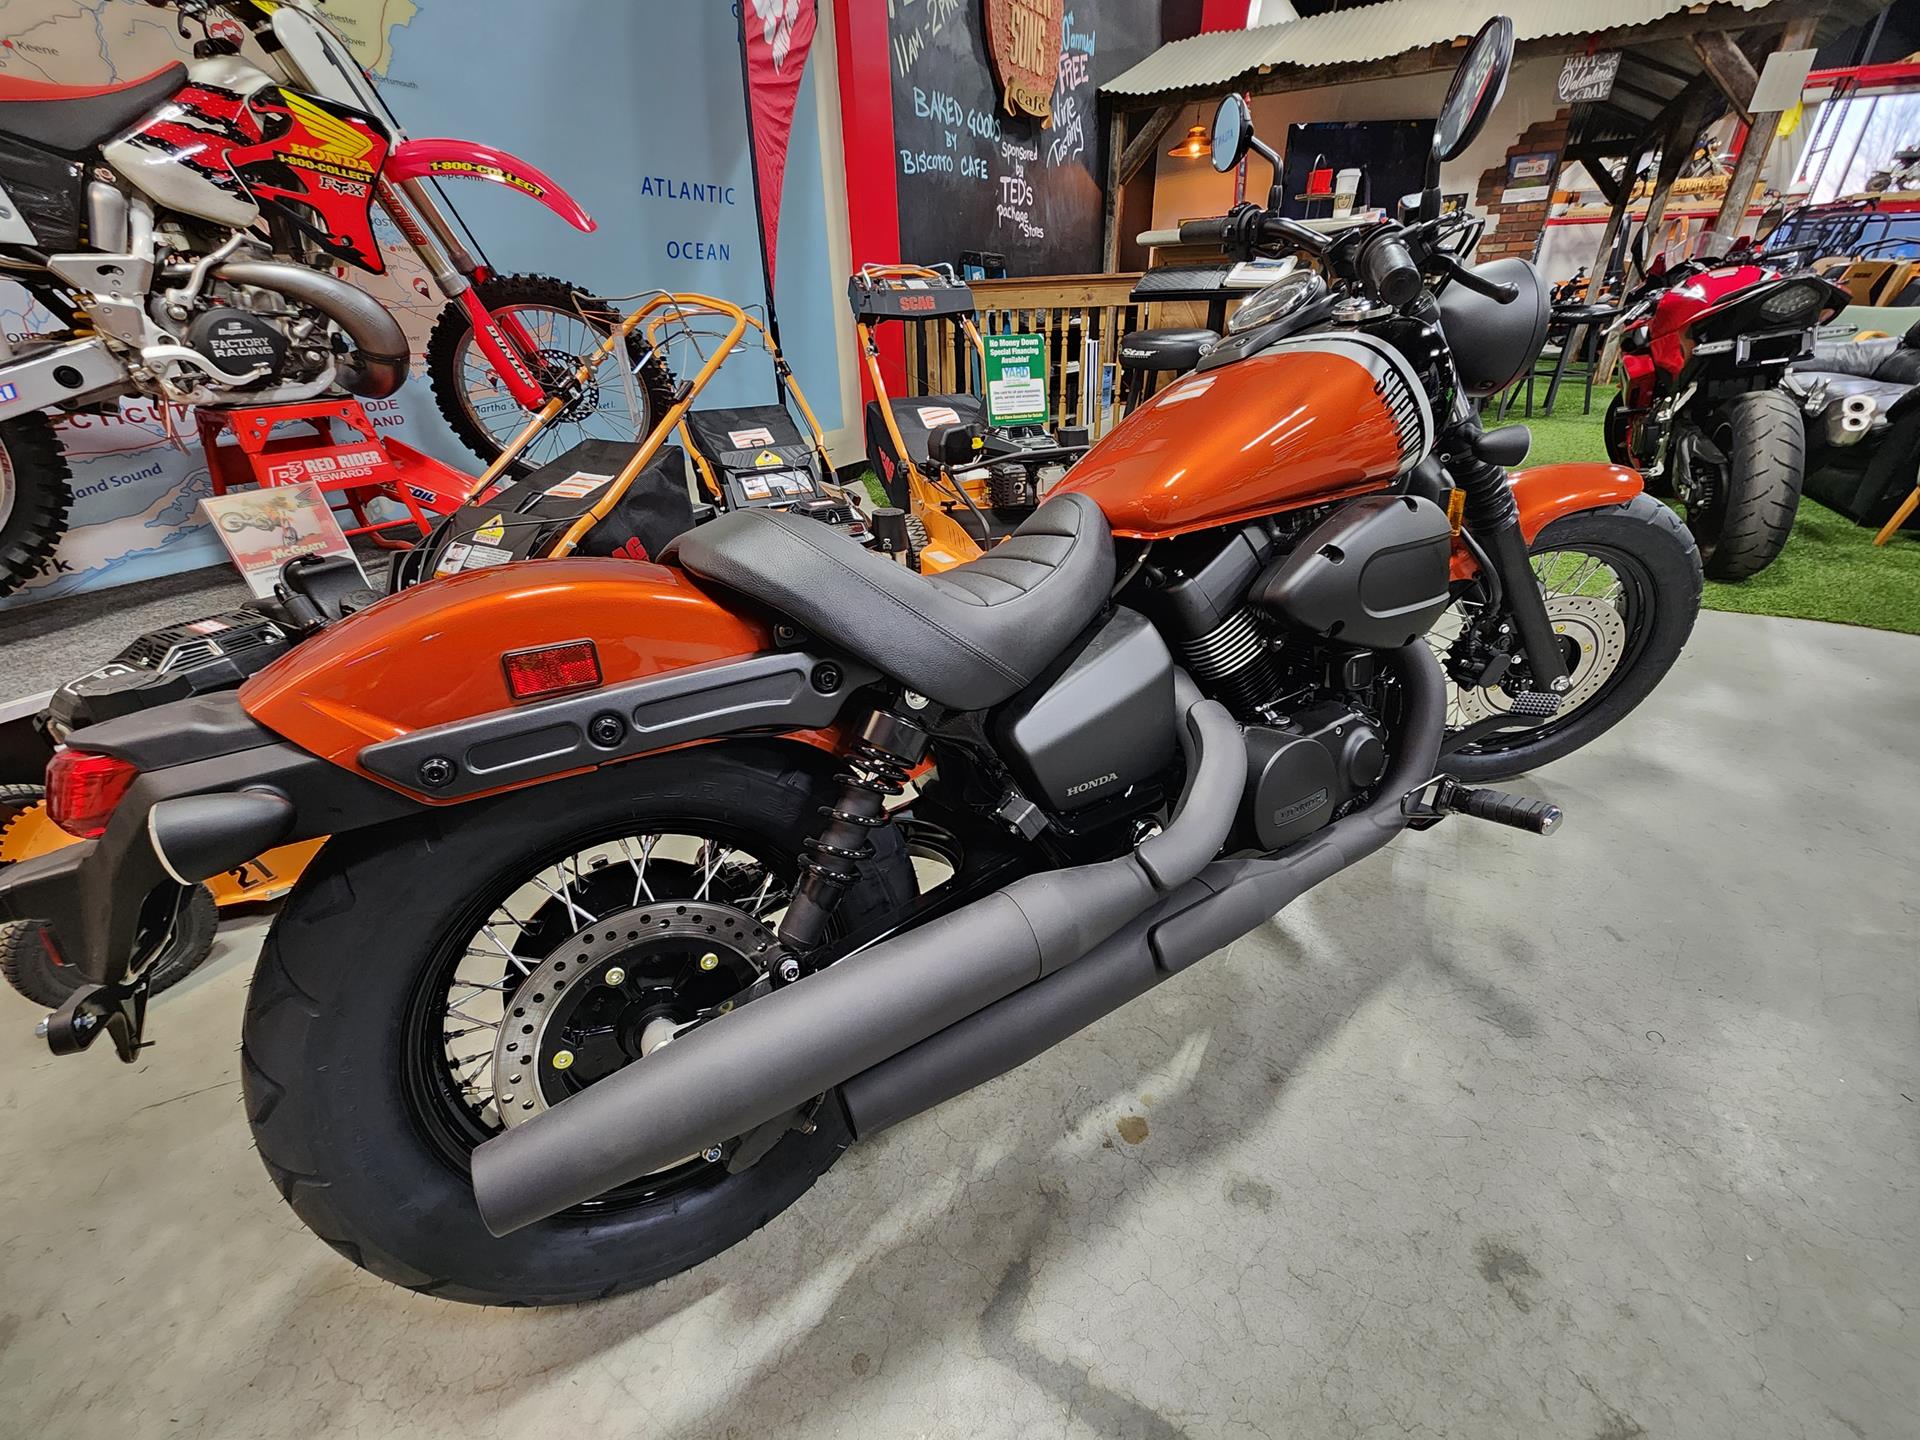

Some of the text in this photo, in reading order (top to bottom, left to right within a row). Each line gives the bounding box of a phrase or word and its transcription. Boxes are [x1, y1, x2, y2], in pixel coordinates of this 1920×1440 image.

[1059, 53, 1089, 95] FREE
[1582, 82, 1608, 99] DAY
[913, 86, 1001, 142] BAKED GOODS
[944, 130, 958, 152] BY
[278, 154, 372, 183] 1-800-COLLECT
[289, 143, 375, 174] HONDA
[960, 154, 988, 180] CAFE
[430, 161, 544, 196] 1-800-COLLECT
[641, 176, 735, 205] ATLANTIC
[666, 241, 730, 261] OCEAN
[209, 337, 270, 349] FACTORY
[213, 346, 275, 358] RACING
[485, 325, 536, 390] DUNLOP
[303, 450, 382, 473] RED RIDER
[109, 462, 163, 488] Sound
[311, 467, 373, 483] REWARDS
[1066, 772, 1118, 797] HONDA
[228, 858, 276, 890] 21
